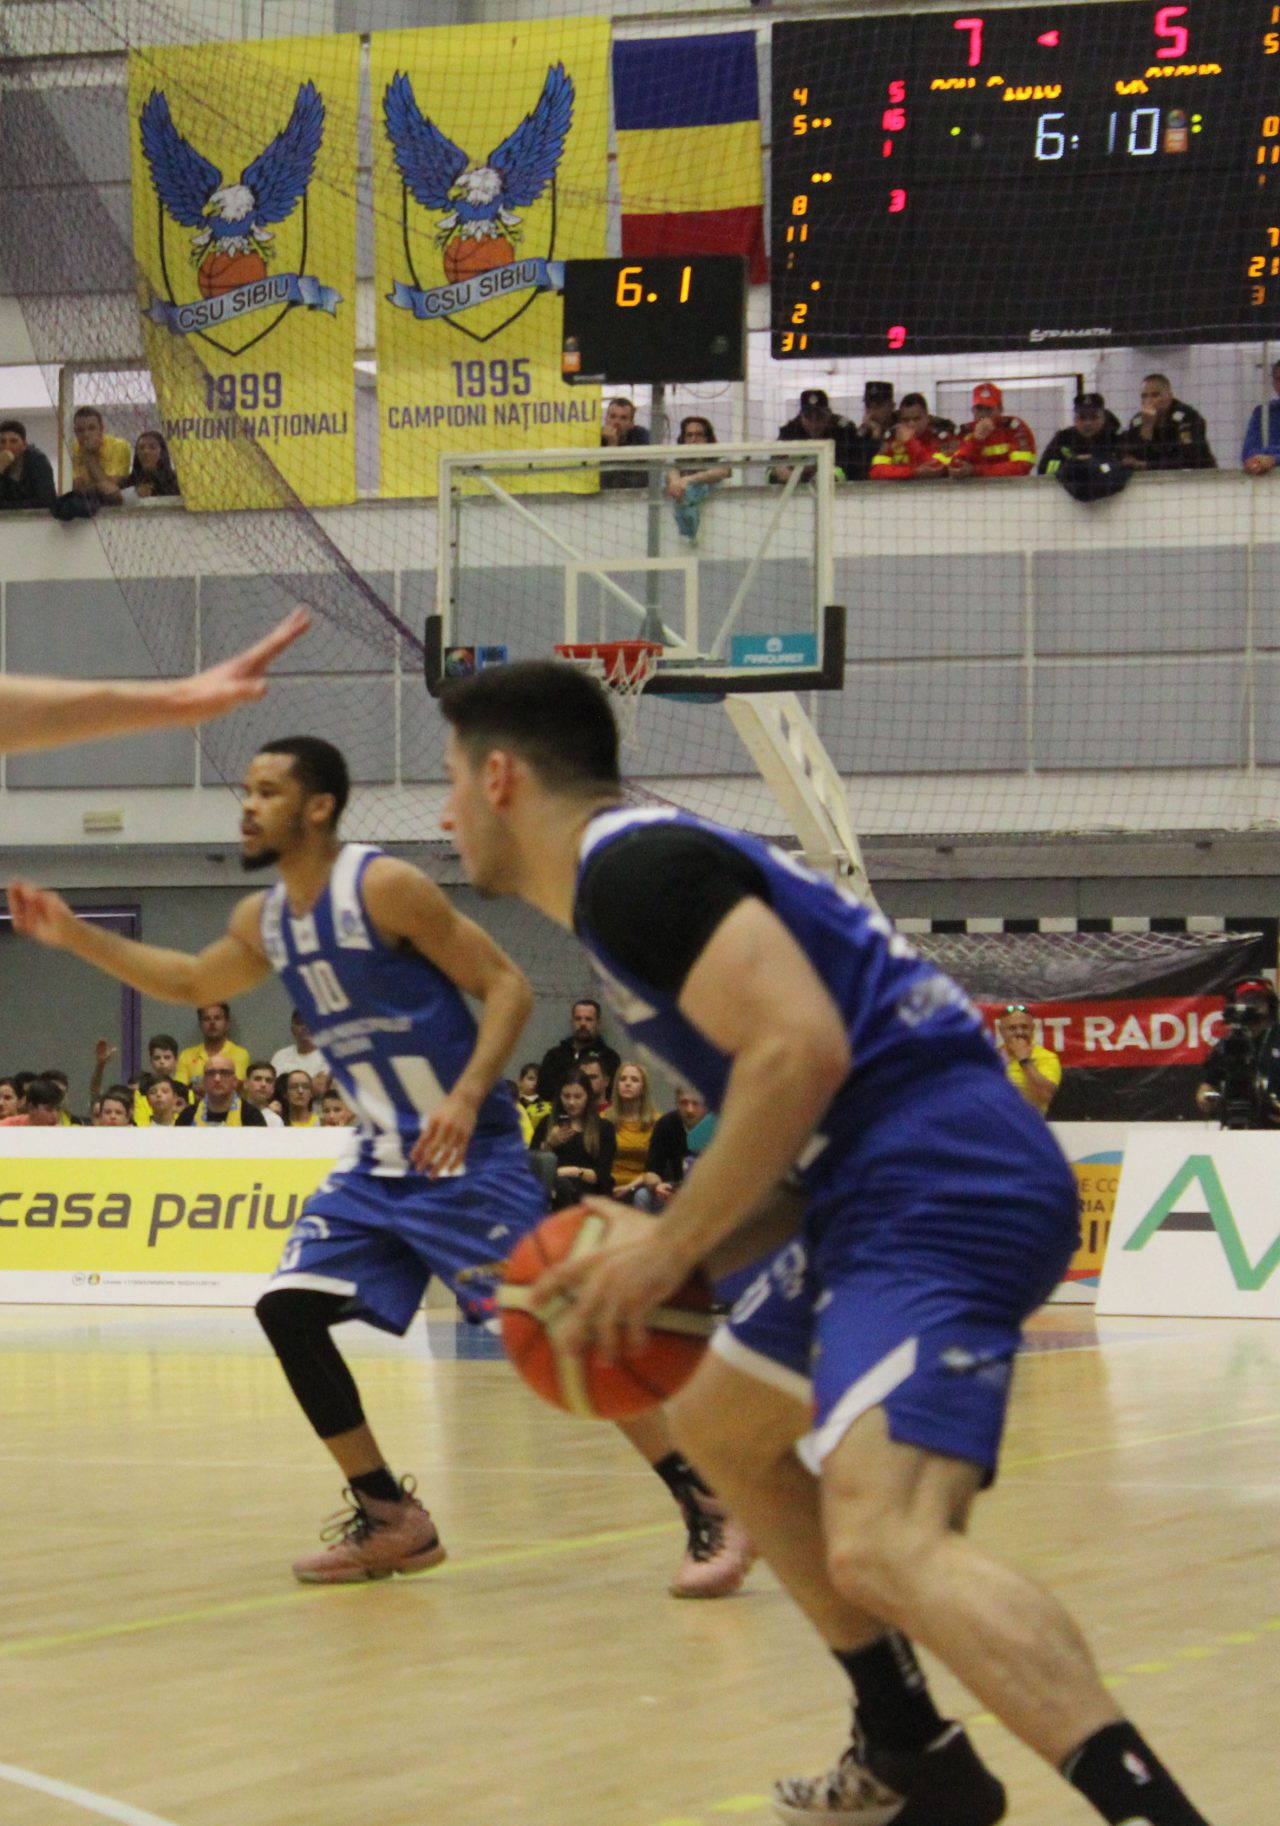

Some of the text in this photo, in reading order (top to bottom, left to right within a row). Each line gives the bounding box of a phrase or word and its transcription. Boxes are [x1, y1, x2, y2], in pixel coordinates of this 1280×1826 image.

[954, 18, 984, 66] 7
[1154, 6, 1188, 58] 5
[793, 88, 808, 106] 4
[793, 114, 807, 135] 5
[786, 224, 808, 242] 11
[179, 278, 289, 329] CSU SIBIU
[425, 262, 537, 314] CSU SIBIU
[792, 303, 808, 324] 2
[781, 332, 808, 351] 31
[205, 372, 283, 411] 1999
[451, 358, 531, 398] 1995
[388, 403, 487, 429] CAMPIONI
[298, 958, 352, 1016] 10
